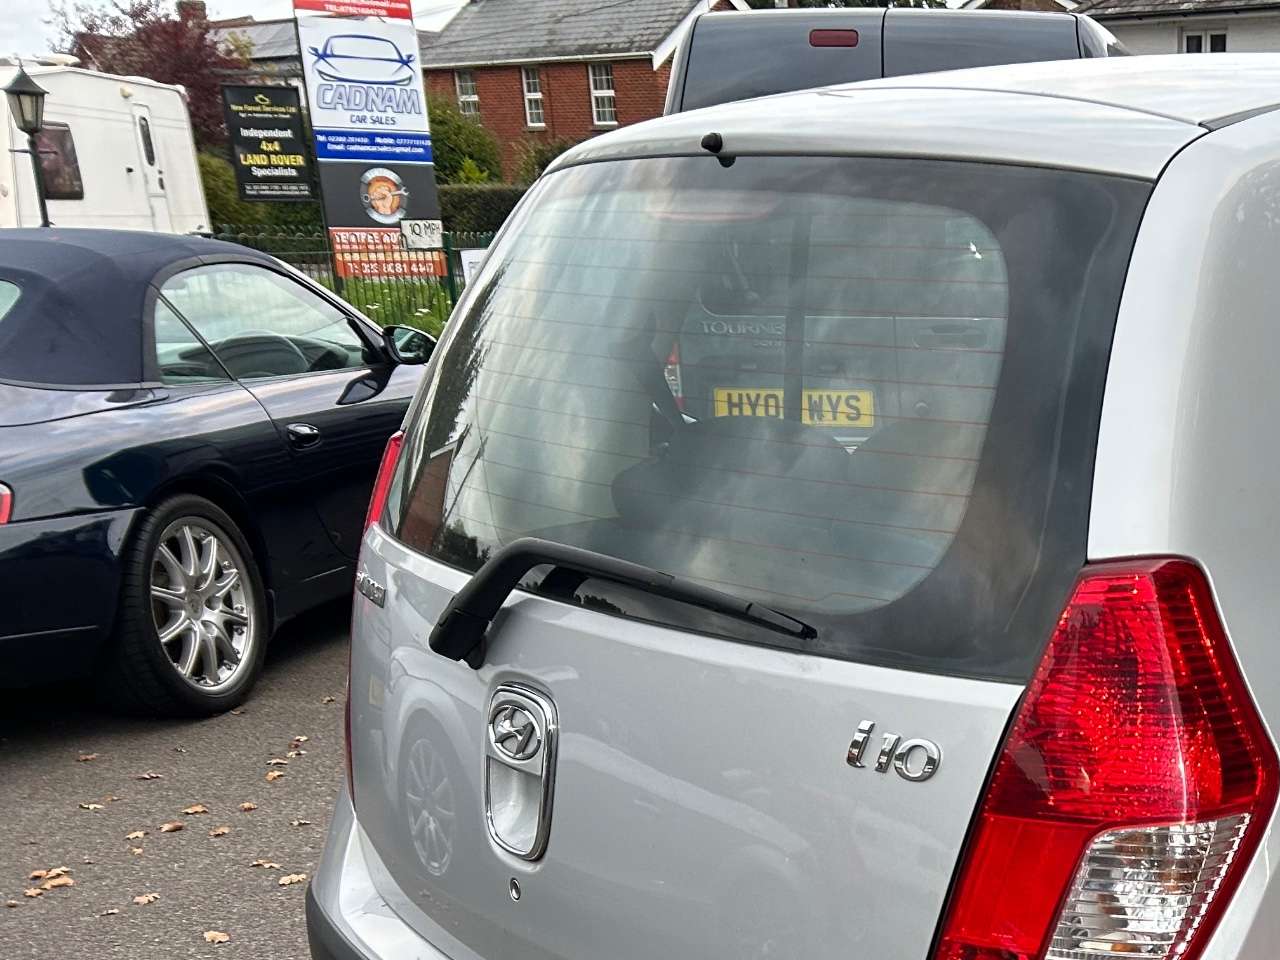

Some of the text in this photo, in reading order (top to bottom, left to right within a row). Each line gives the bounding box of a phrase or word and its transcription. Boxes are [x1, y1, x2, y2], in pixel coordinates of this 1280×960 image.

[317, 84, 421, 114] CADNAM
[350, 115, 396, 126] CAR SALES
[240, 128, 293, 139] Independent
[260, 140, 280, 152] 4x4
[240, 153, 304, 166] LAND ROVER
[251, 166, 298, 177] Specialists
[807, 394, 861, 421] WYS
[847, 719, 942, 782] i10
